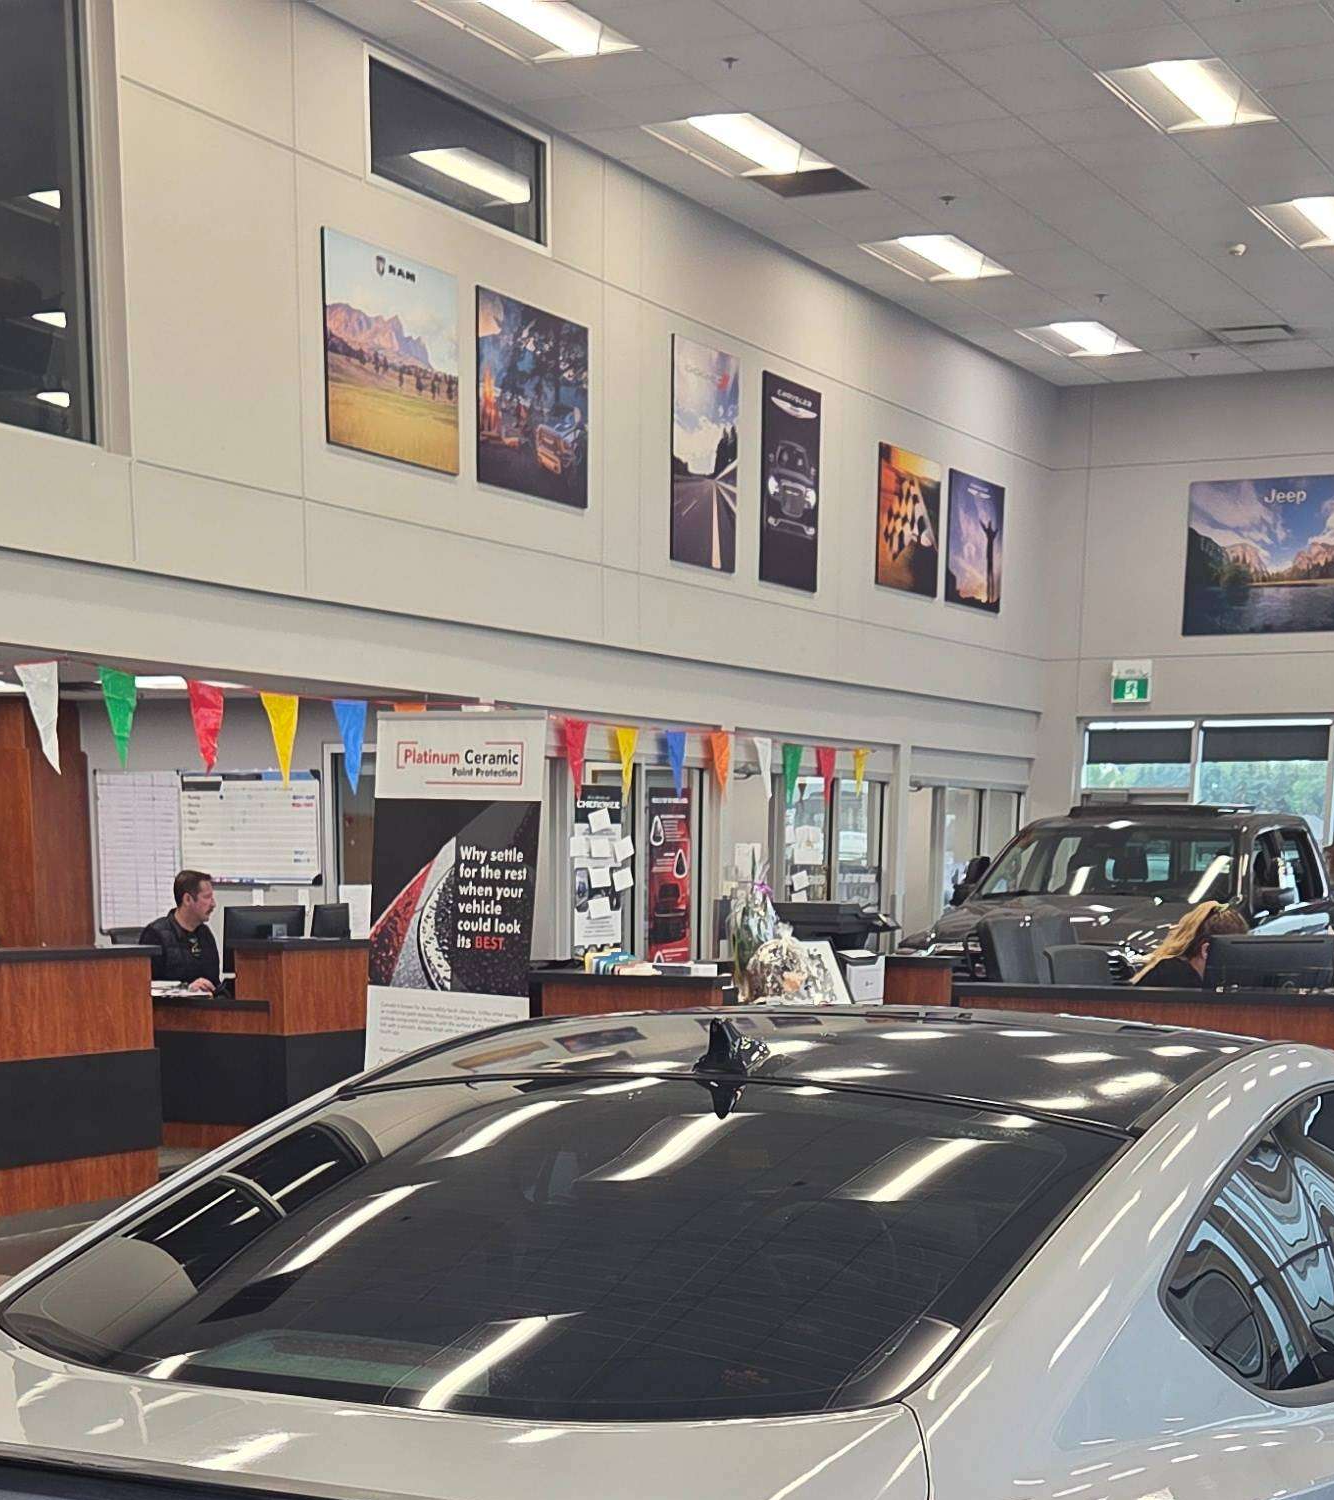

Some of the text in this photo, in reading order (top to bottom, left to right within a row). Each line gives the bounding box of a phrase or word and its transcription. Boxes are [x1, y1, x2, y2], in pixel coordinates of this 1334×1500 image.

[388, 264, 416, 283] RAM
[1263, 488, 1307, 505] Jeep
[404, 748, 519, 765] Platinum Ceramic
[475, 767, 518, 777] Protection
[460, 845, 524, 865] Why settle
[459, 862, 527, 881] for the rest
[458, 880, 524, 901] when your
[458, 898, 502, 915] vehicle
[457, 917, 521, 934] could look
[456, 933, 506, 951] its BEST.
